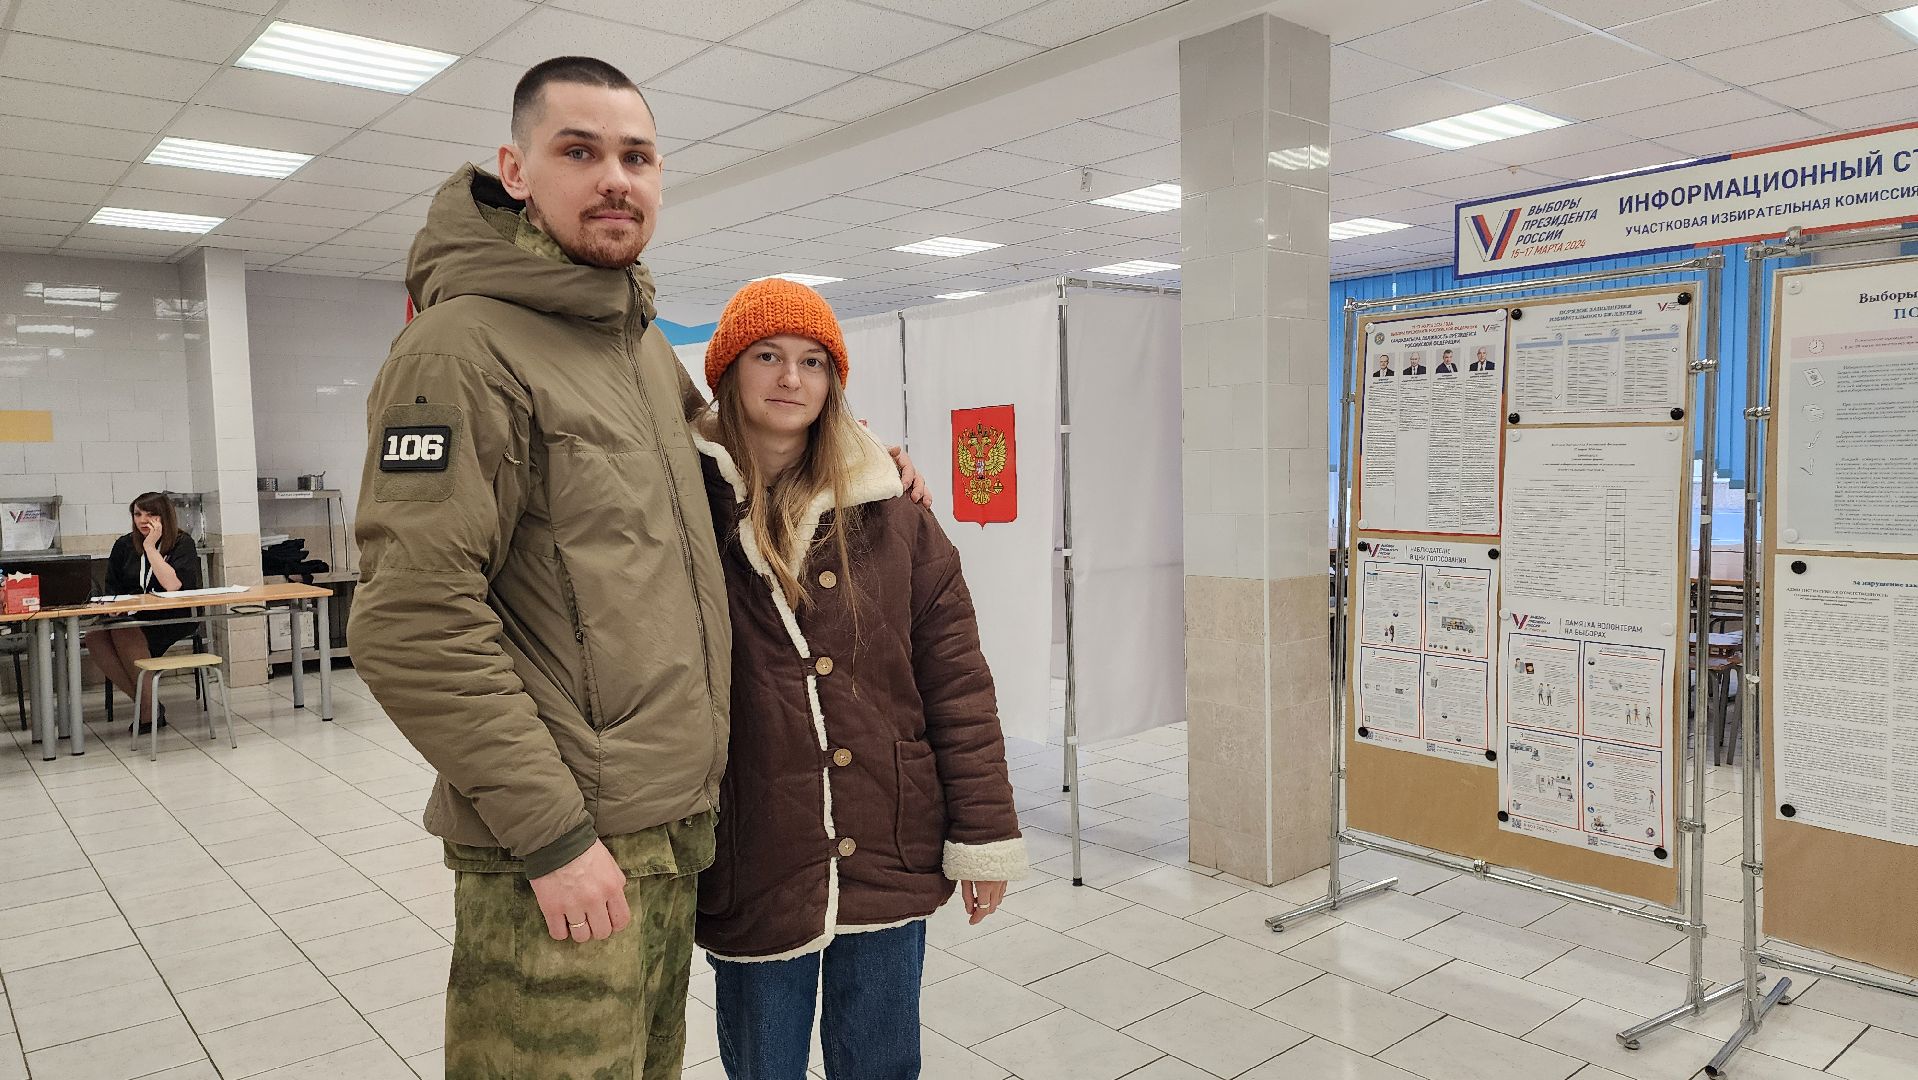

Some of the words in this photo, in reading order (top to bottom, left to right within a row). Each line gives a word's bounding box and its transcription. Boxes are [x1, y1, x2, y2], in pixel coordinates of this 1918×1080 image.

[1618, 150, 1883, 215] ИНФОРМАЦИОННЫЙ
[1527, 197, 1582, 217] ВЫБОРЫ
[1625, 215, 1708, 237] УЧАСТКОВАЯ
[1711, 197, 1831, 225] ИЗБИРАТЕЛЬНАЯ
[1835, 185, 1918, 207] КОМИССИЯ
[1521, 209, 1598, 231] ПРЕЗИДЕНТА
[1515, 229, 1564, 246] РОССИИ
[1534, 242, 1563, 255] МАРТА
[1564, 239, 1586, 251] 2024
[384, 434, 445, 461] 106
